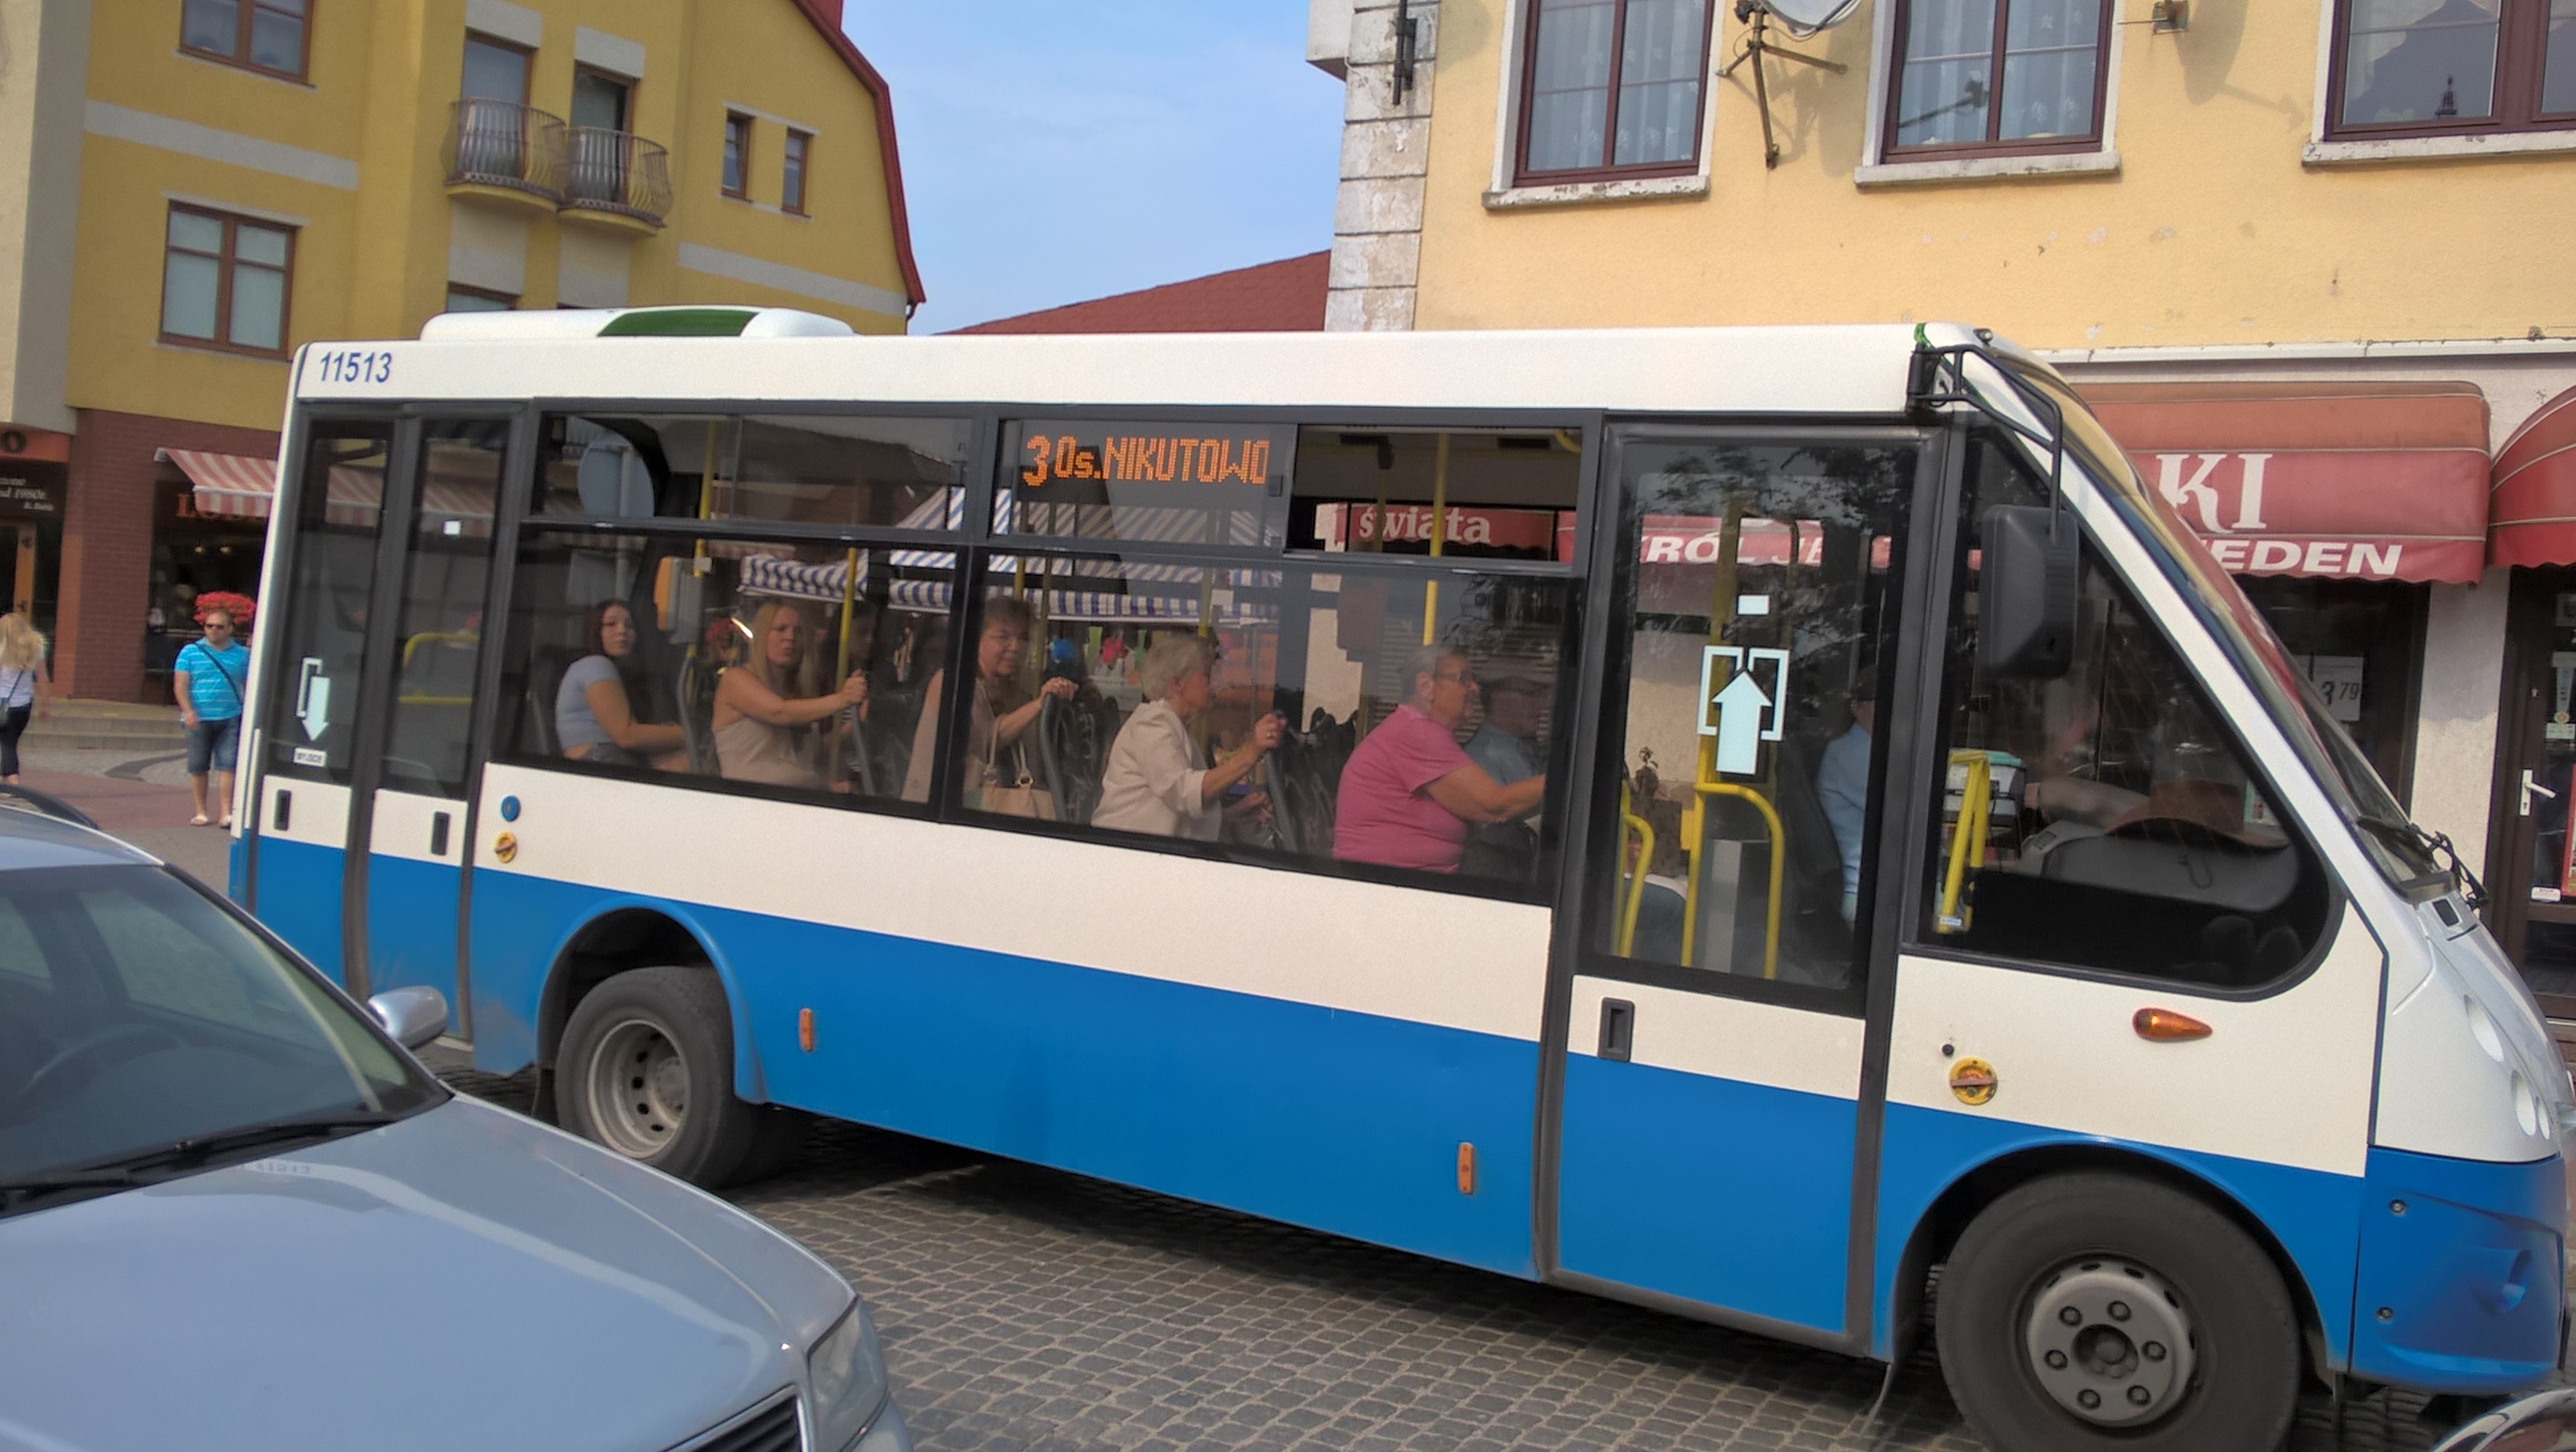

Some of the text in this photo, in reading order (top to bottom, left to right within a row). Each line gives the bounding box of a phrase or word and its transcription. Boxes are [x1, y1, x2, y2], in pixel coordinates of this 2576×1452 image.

[320, 351, 392, 383] 11513
[1024, 436, 1050, 486] 3
[2200, 539, 2402, 575] EDEN
